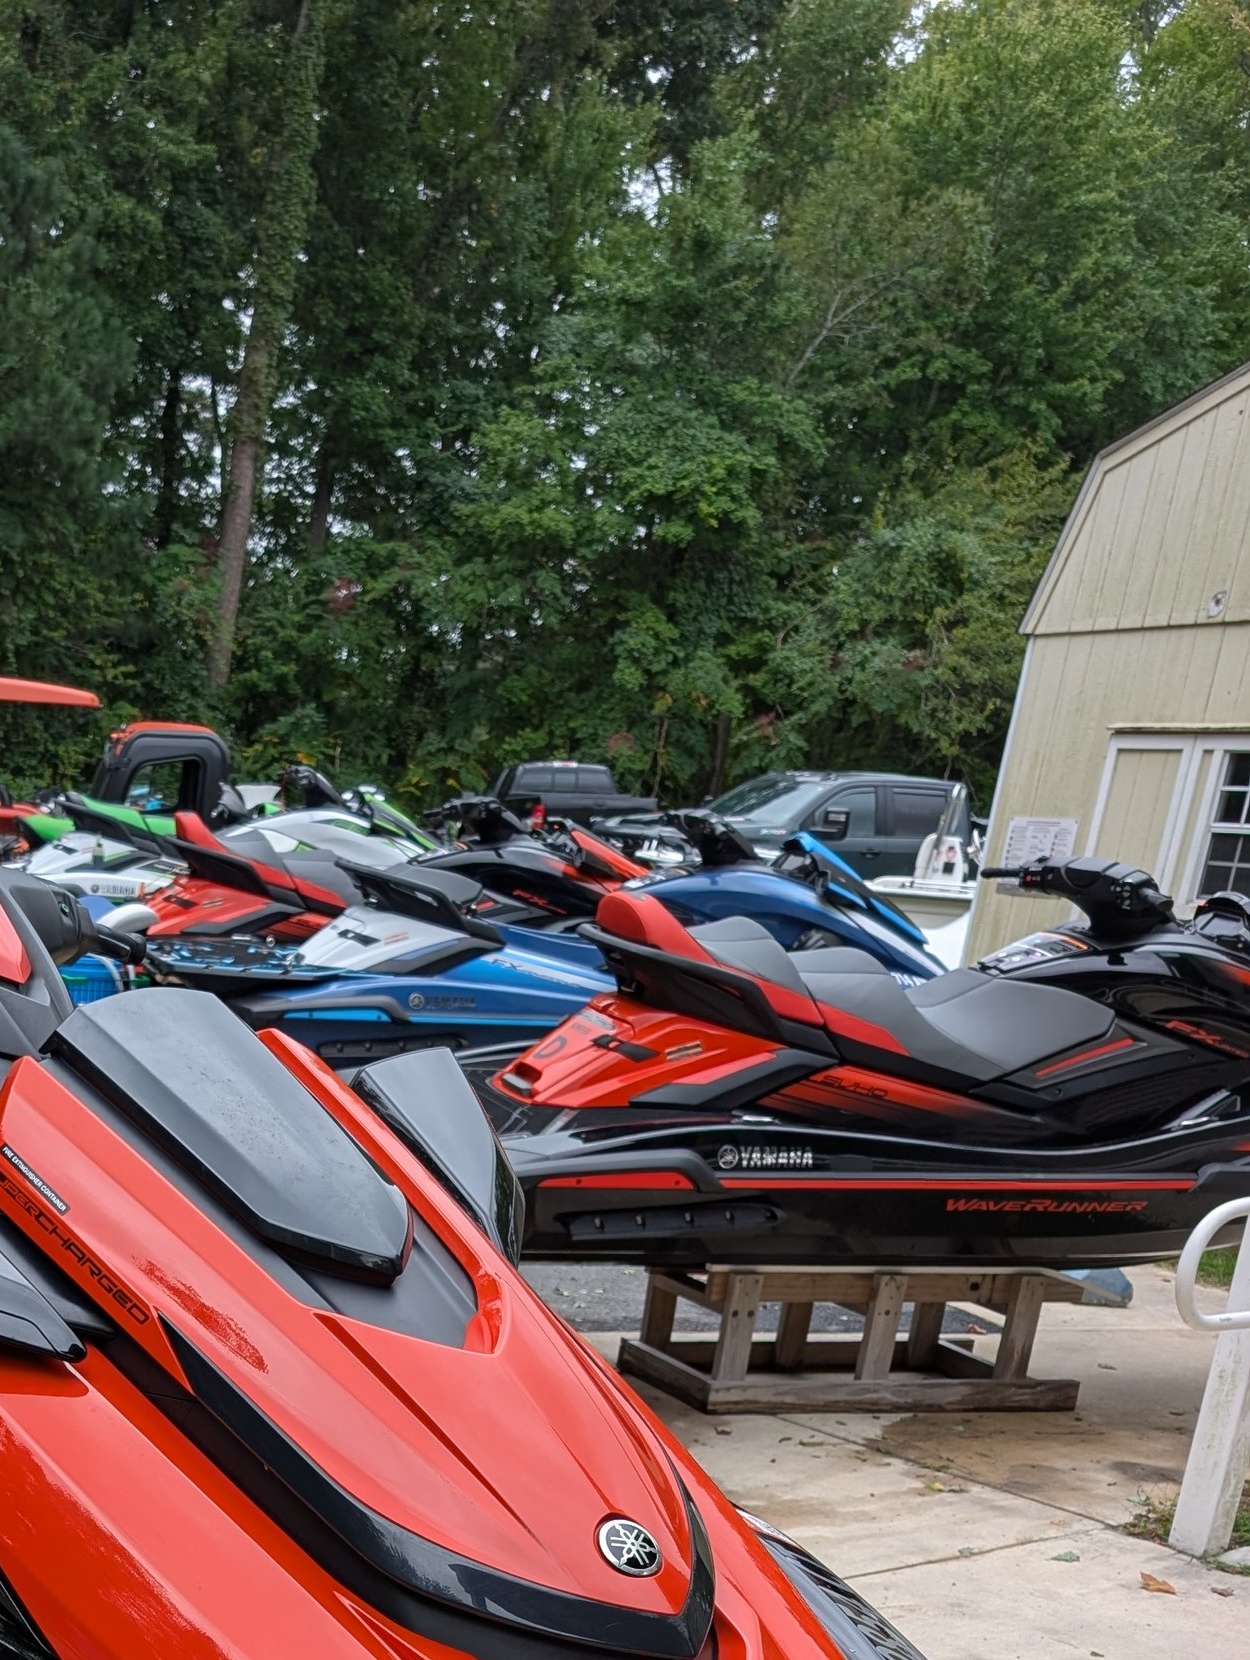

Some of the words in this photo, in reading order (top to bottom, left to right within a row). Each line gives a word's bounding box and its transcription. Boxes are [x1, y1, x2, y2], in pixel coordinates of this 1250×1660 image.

[2, 1146, 15, 1162] FIRE
[12, 1155, 43, 1188] EXTINGUISHER
[40, 1184, 67, 1212] CONTAINER
[739, 1146, 813, 1168] YAMAHA
